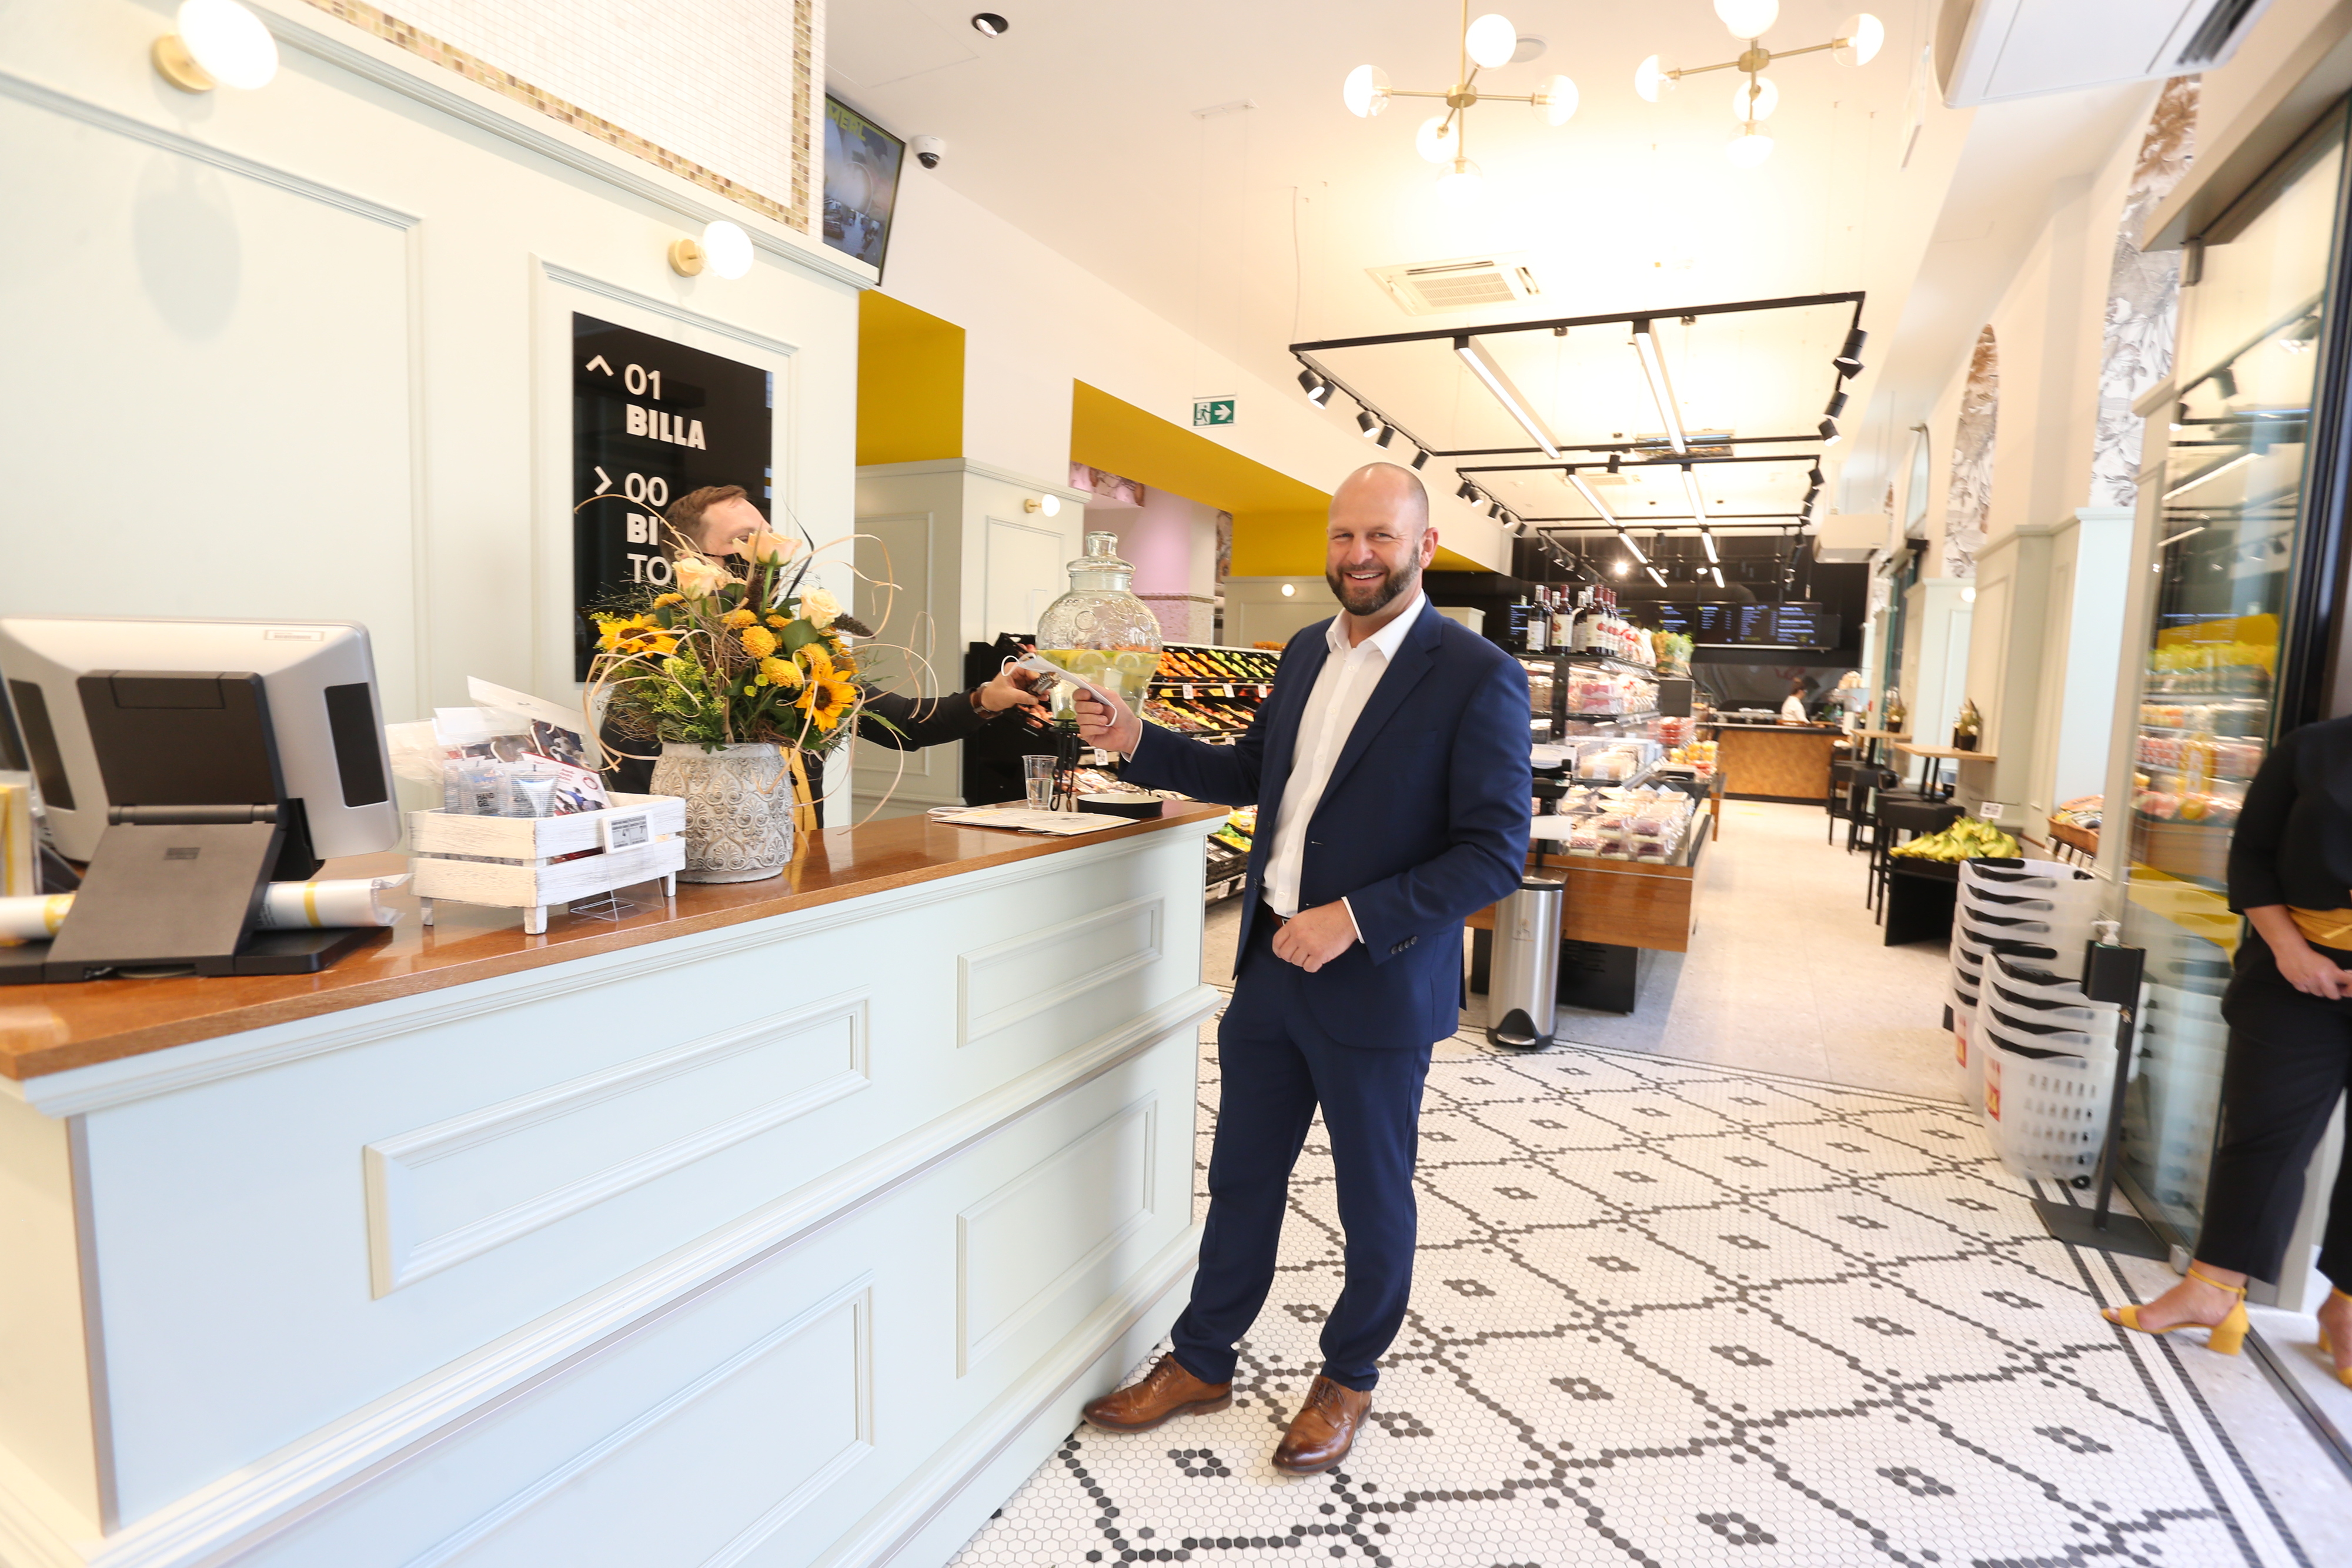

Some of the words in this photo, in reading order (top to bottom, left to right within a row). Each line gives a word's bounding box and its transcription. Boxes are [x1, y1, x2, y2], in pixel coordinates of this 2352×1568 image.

[624, 363, 660, 400] 01
[626, 403, 706, 450] BILLA
[624, 472, 669, 507] 00
[626, 513, 663, 546] BI
